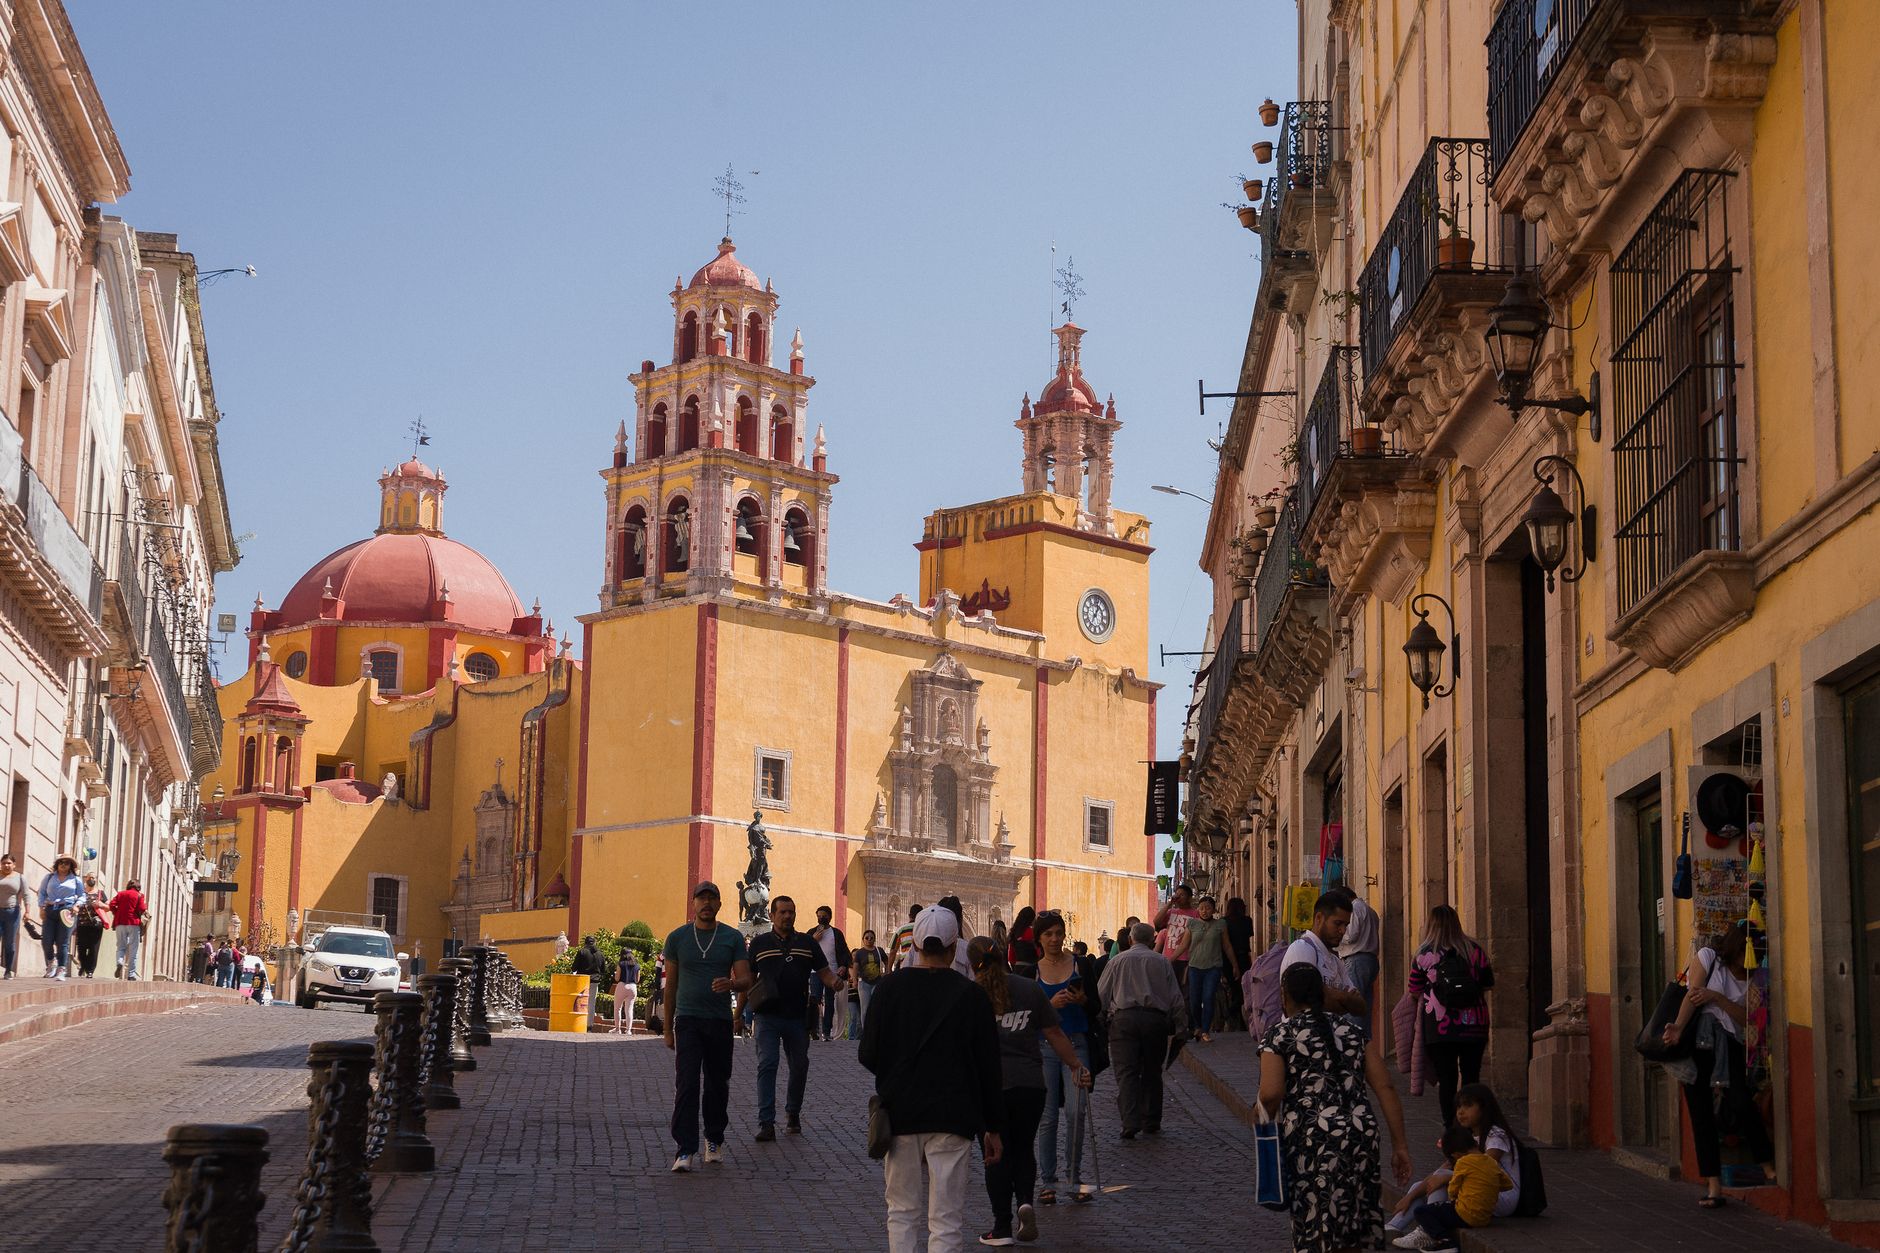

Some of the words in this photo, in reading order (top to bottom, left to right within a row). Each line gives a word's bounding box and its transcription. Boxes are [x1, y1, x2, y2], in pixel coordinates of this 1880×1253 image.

[1539, 30, 1557, 72] HOTEL
[1168, 913, 1191, 927] JUST
[1168, 925, 1185, 938] DO
[995, 1010, 1032, 1031] OFF
